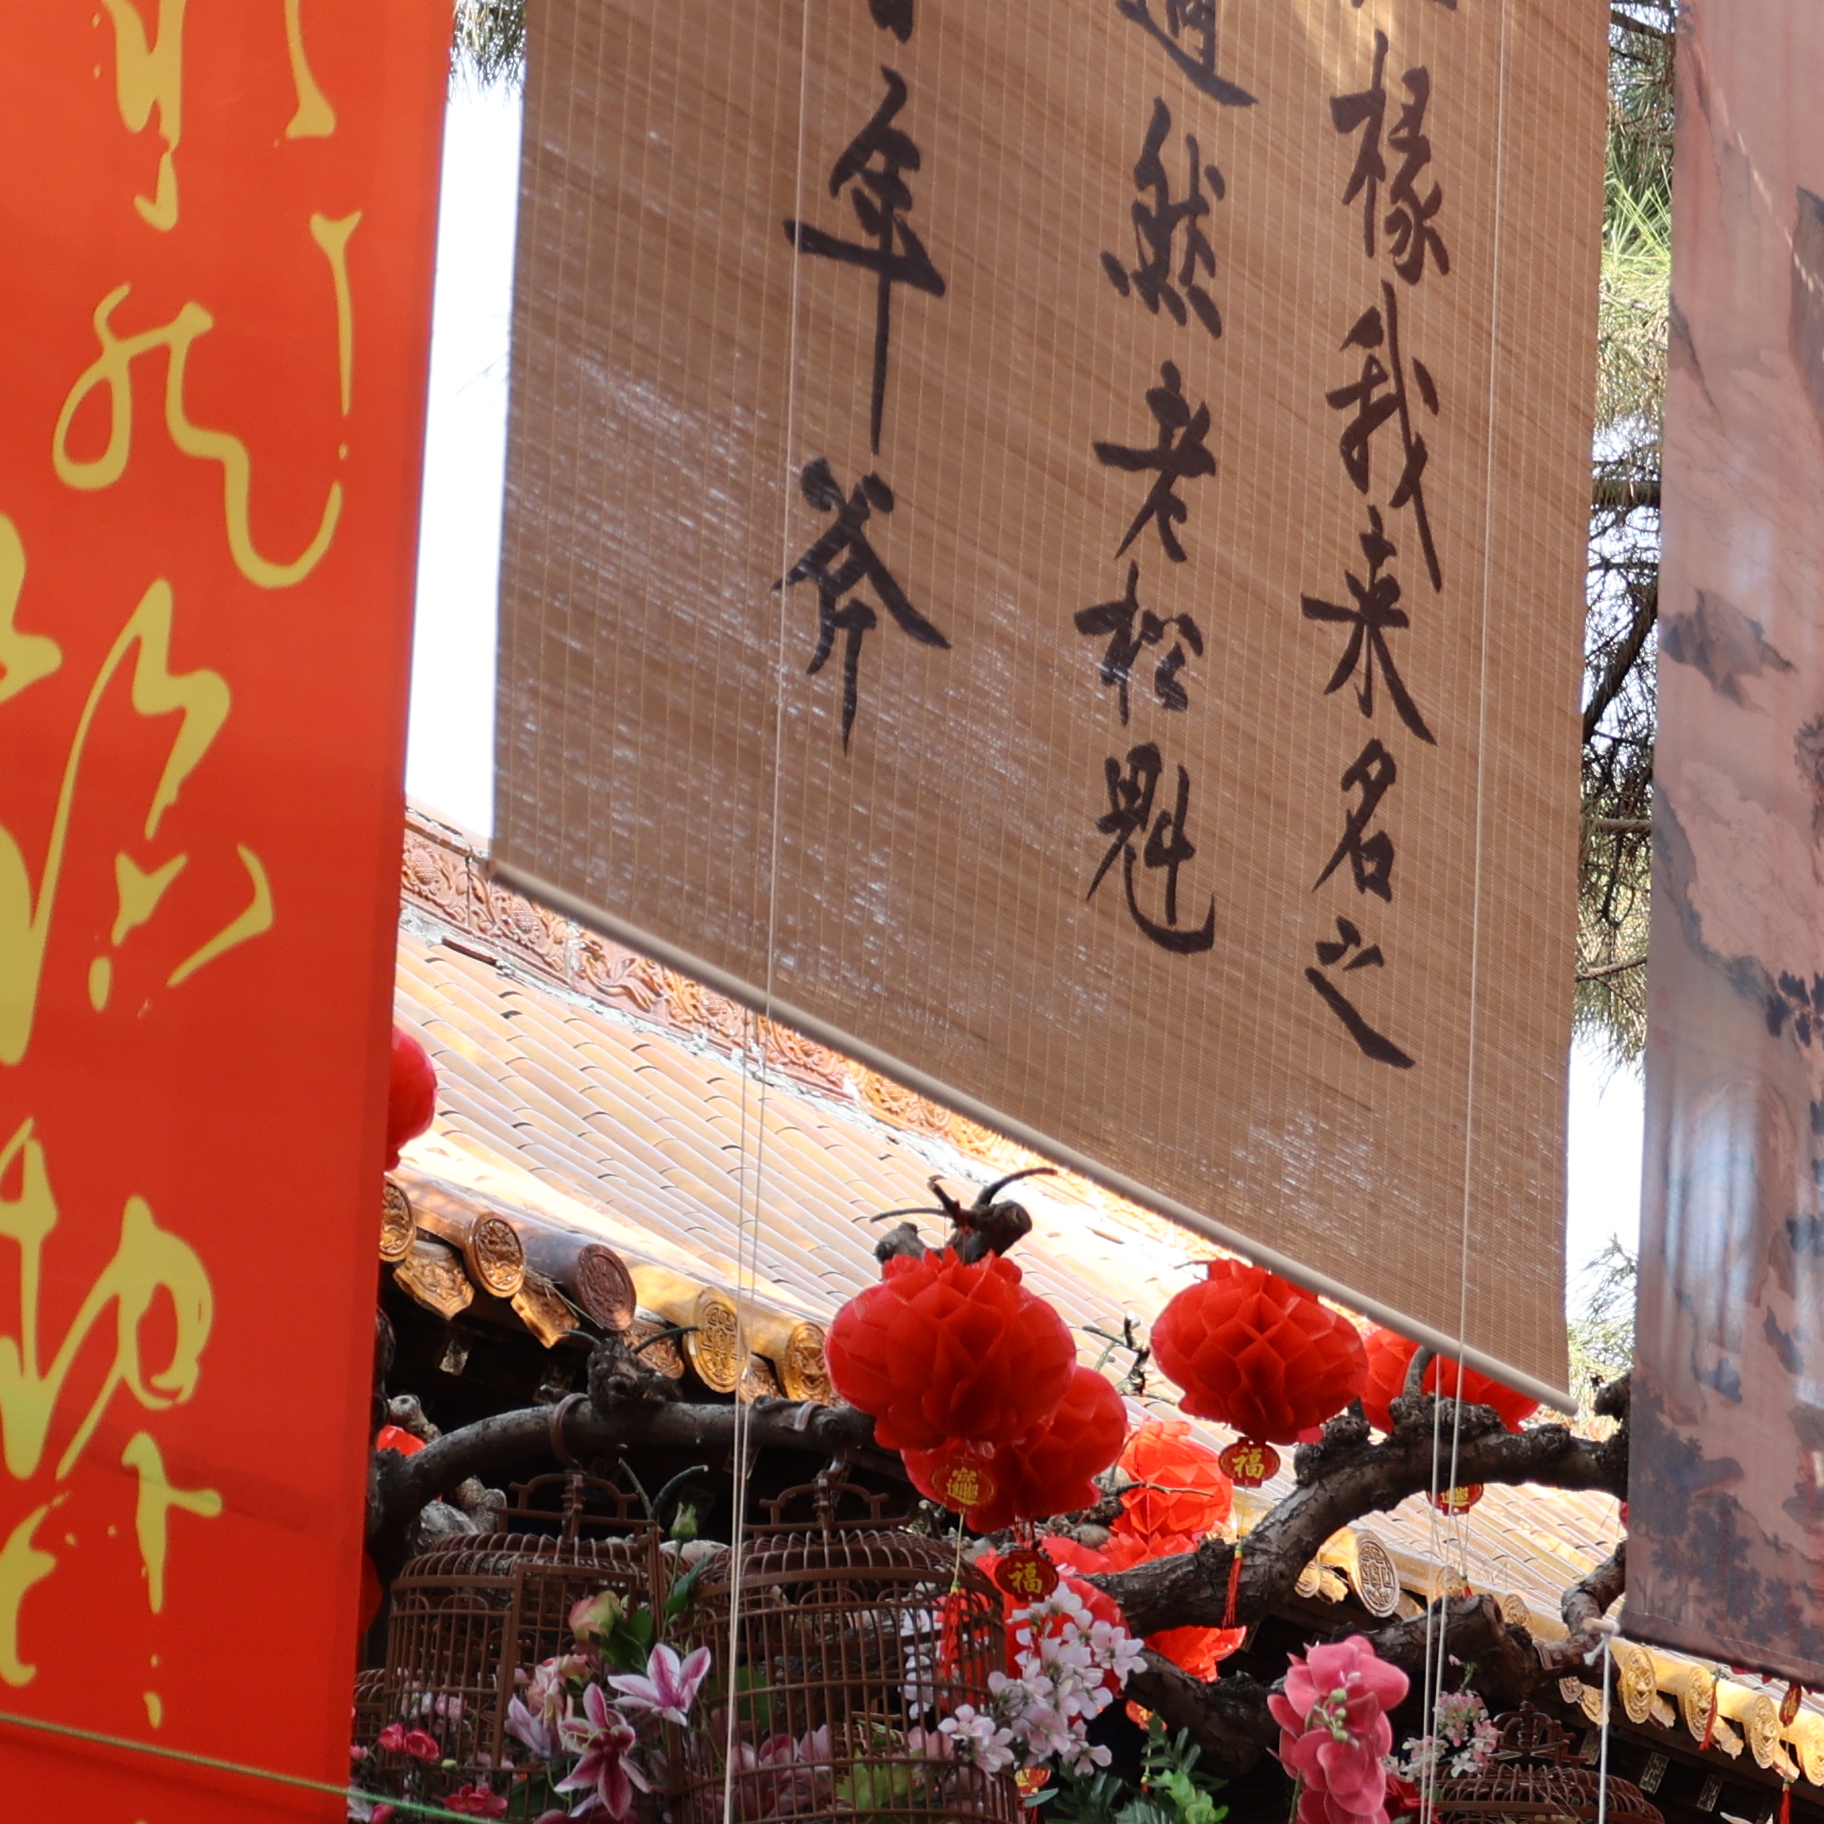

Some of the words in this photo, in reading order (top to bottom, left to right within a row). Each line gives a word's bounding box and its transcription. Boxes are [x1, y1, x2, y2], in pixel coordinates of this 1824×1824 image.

[775, 0, 952, 757] 年斧
[1231, 1448, 1266, 1480] 福
[1009, 1562, 1043, 1596] 福
